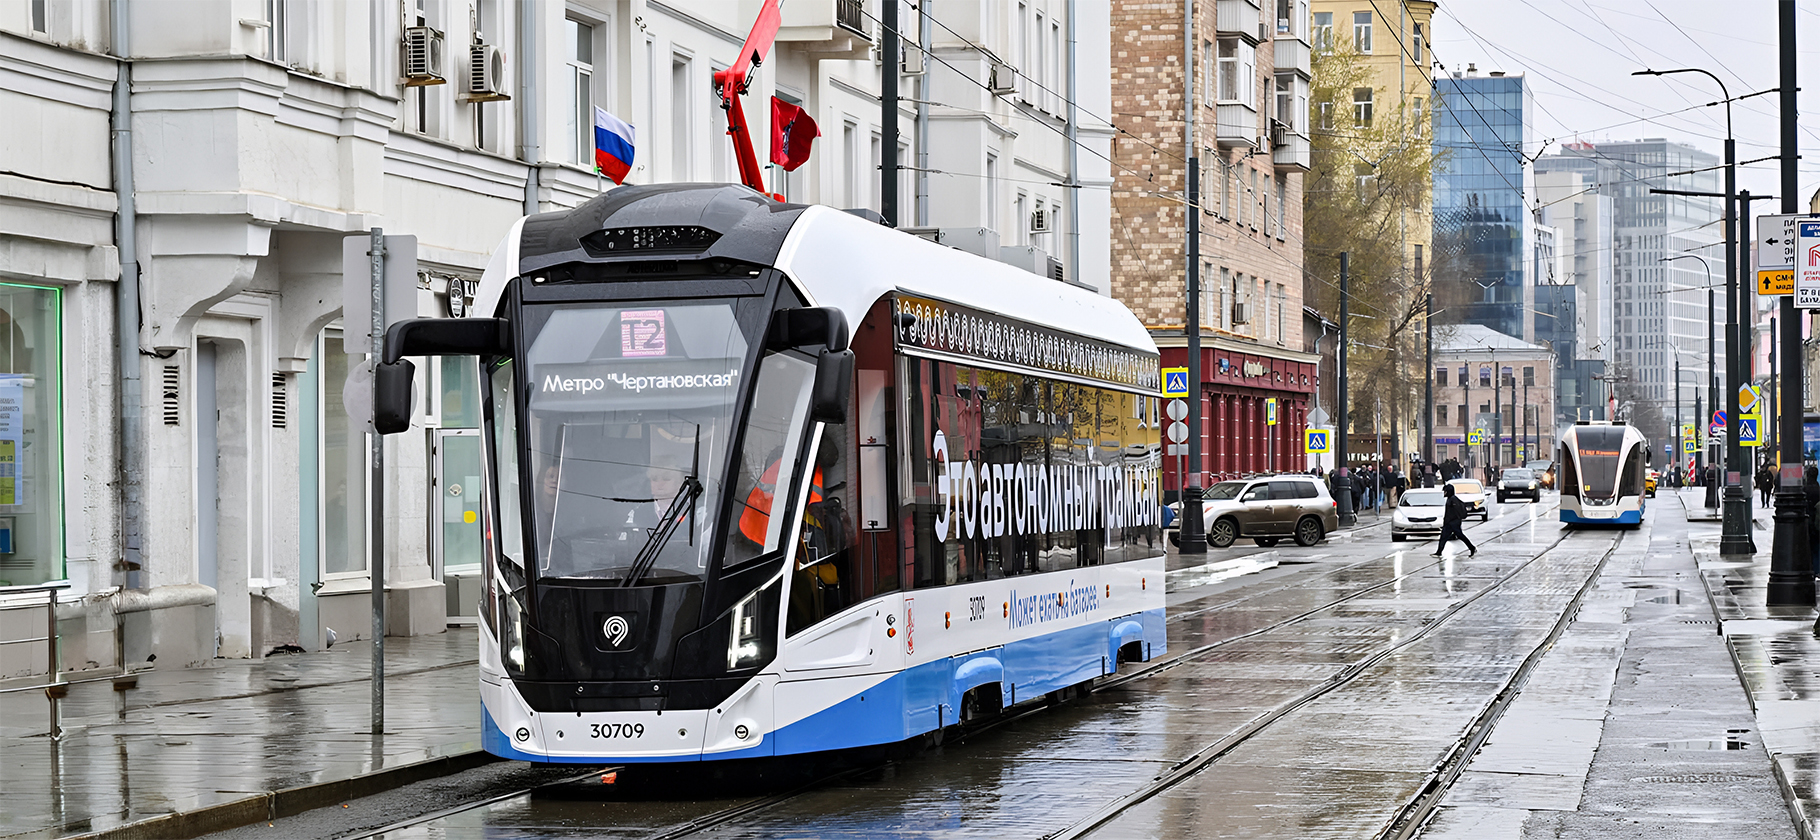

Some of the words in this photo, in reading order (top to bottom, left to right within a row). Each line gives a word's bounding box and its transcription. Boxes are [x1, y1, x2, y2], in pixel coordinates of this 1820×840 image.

[621, 319, 665, 350] Т2
[543, 374, 605, 394] Метро
[607, 369, 738, 393] "Чертановская"
[933, 429, 977, 543] Это
[980, 438, 1097, 540] автономный
[970, 595, 985, 621] 30709
[1008, 589, 1037, 630] Может
[1040, 592, 1060, 622] ехать
[590, 723, 645, 739] 30709
